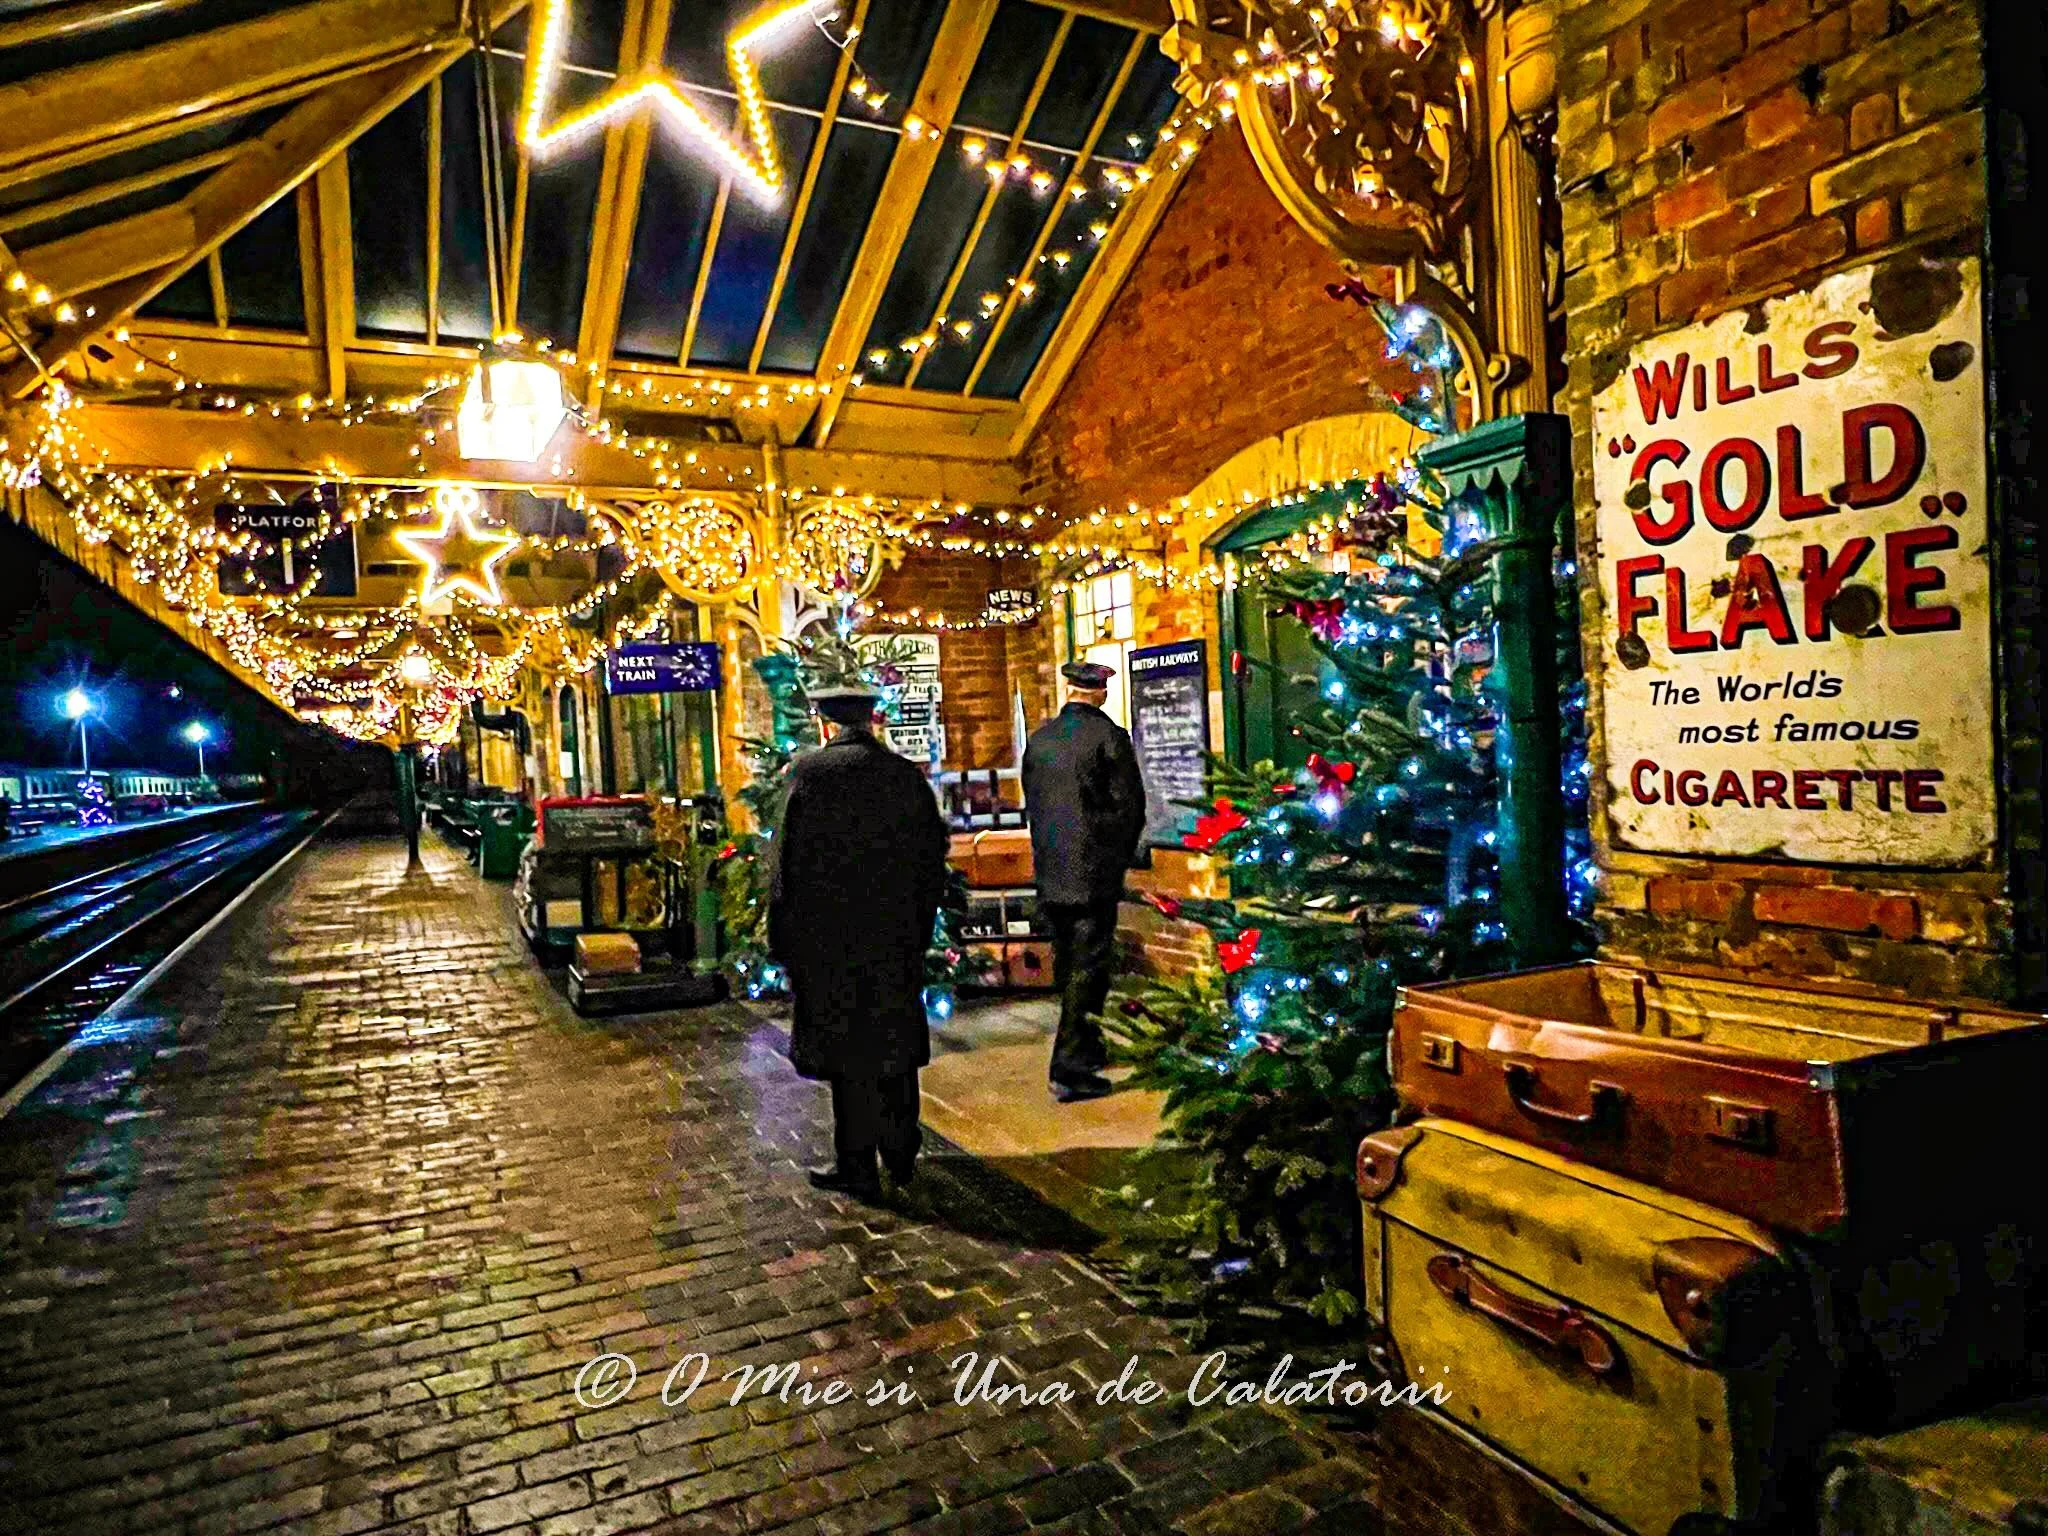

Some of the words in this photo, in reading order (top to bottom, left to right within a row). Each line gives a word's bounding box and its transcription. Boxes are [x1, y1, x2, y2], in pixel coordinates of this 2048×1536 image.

[1633, 321, 1860, 425] WILLS
[238, 515, 329, 529] PLATFOR
[989, 589, 1033, 604] NEWS
[618, 656, 655, 667] NEXT
[1131, 656, 1158, 671] BRITISH
[1159, 650, 1199, 667] RAILWAYS
[617, 670, 656, 681] TRAIN
[1649, 680, 1700, 706] The
[1717, 670, 1844, 703] World's
[1679, 717, 1760, 744] most
[1774, 712, 1920, 743] famous
[1630, 758, 1948, 814] CIGARETTE
